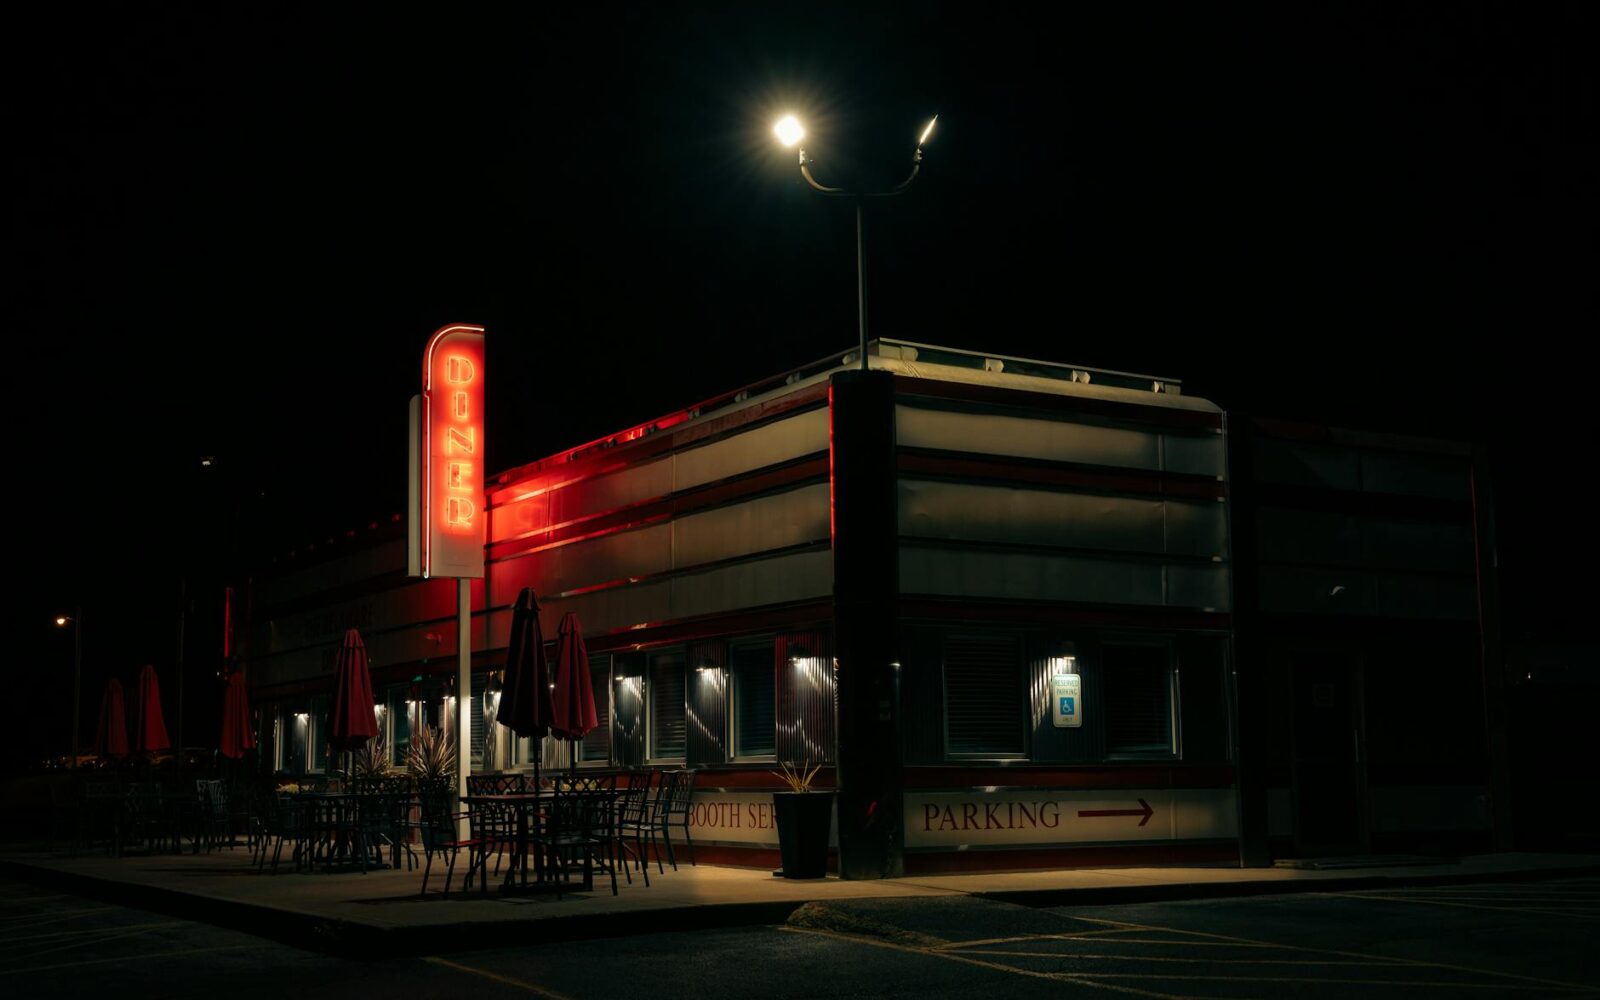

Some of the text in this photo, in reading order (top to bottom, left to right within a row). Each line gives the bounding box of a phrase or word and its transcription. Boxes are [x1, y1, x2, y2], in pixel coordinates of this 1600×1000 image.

[447, 356, 475, 526] DINER
[1056, 688, 1078, 696] PARKING
[687, 802, 740, 828] BOOTH
[922, 800, 1062, 831] PARKING
